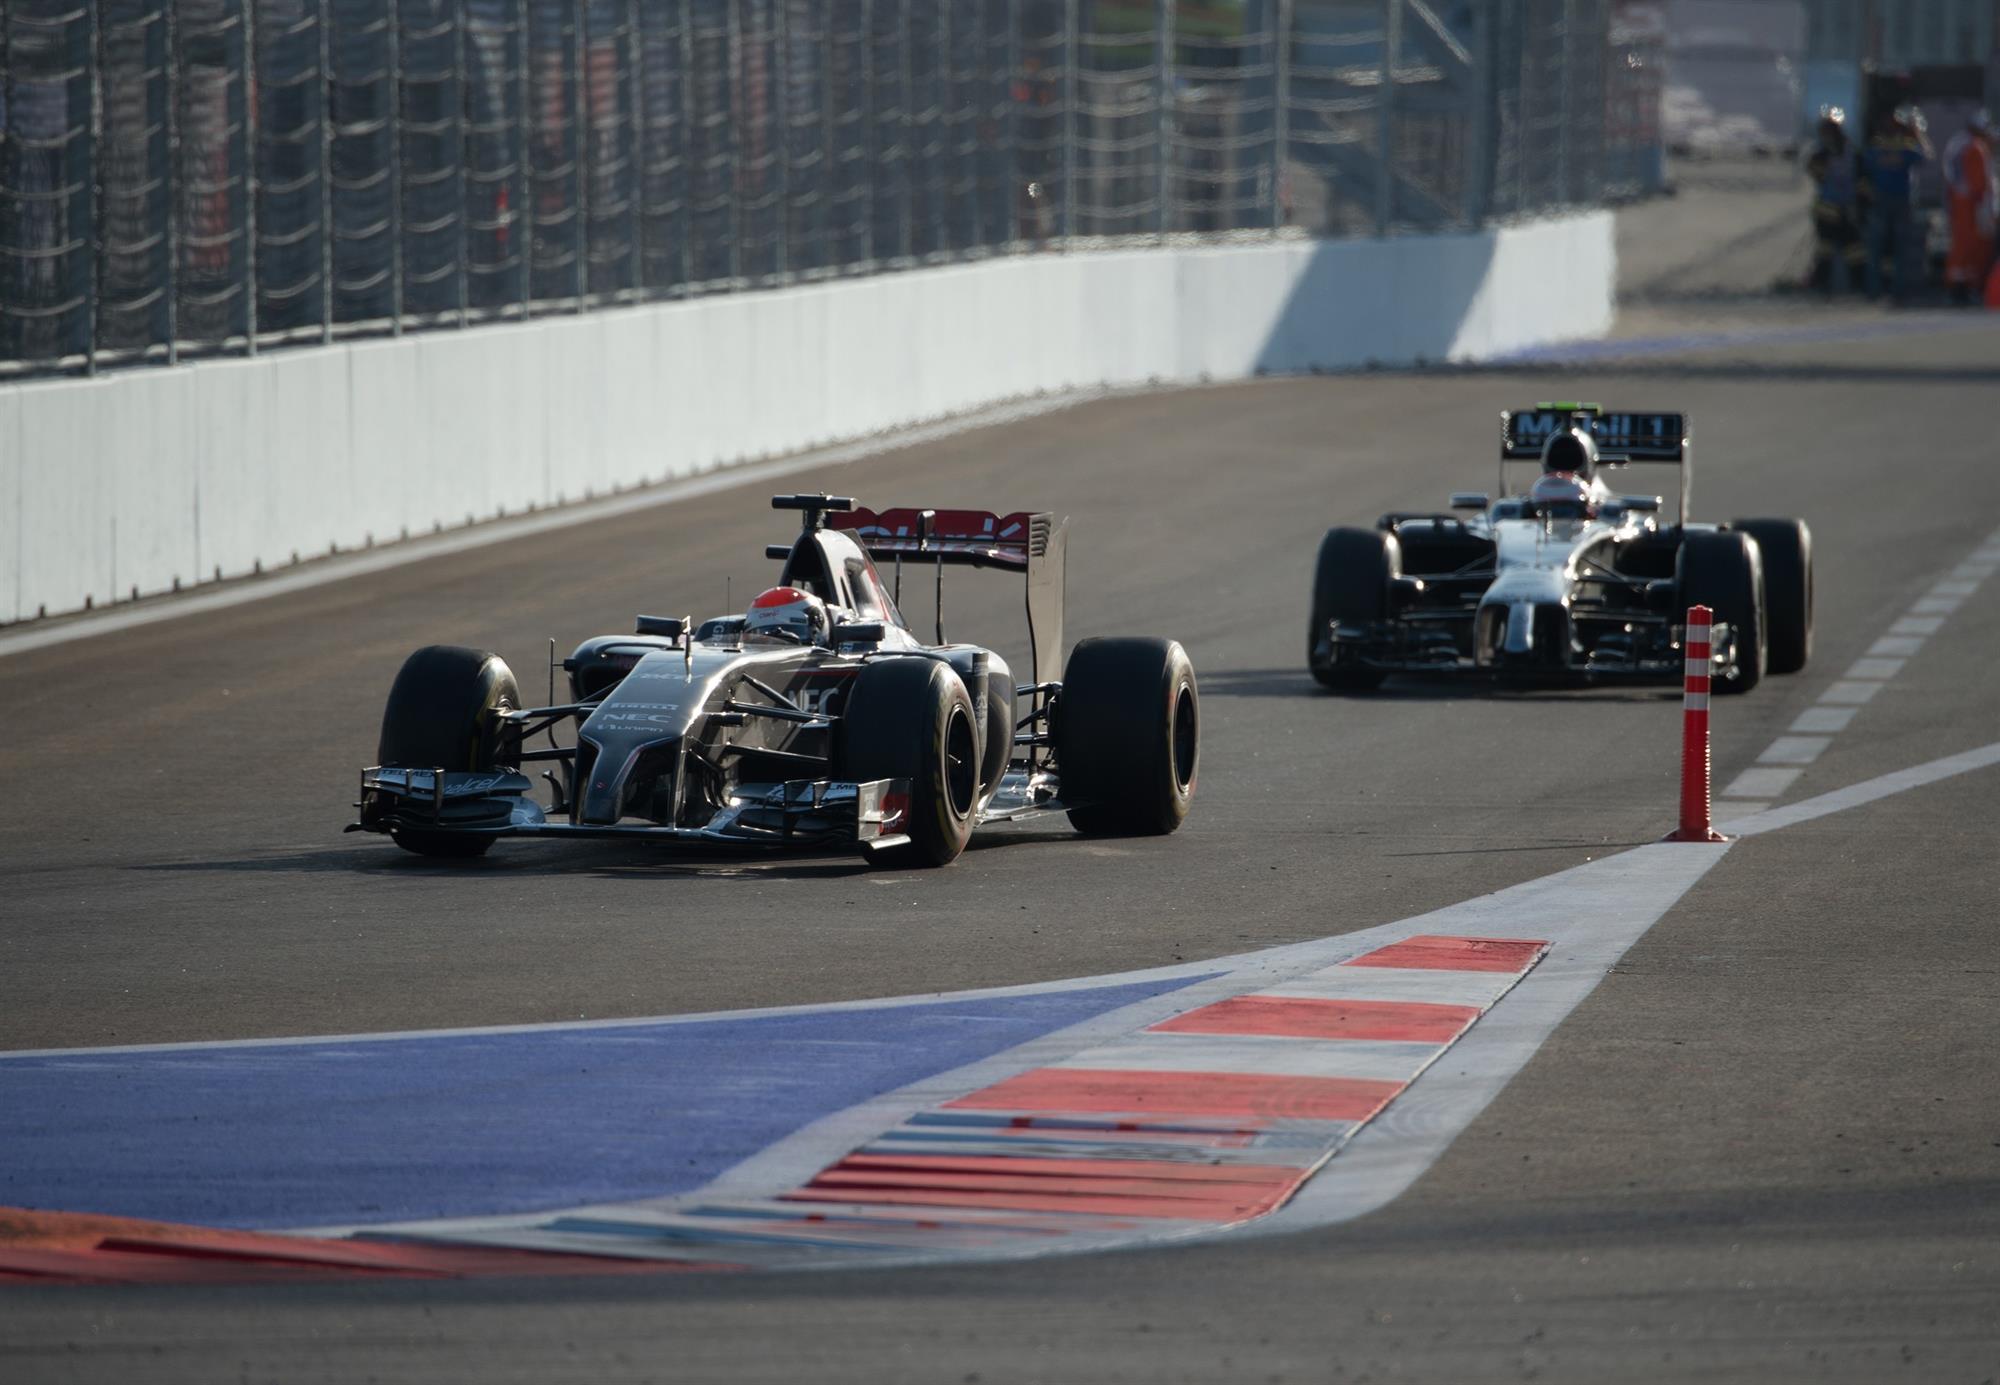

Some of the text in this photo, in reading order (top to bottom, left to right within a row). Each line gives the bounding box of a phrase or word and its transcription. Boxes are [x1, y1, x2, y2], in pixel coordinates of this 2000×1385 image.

[1516, 413, 1663, 447] Mbil 1
[602, 713, 673, 724] NEC
